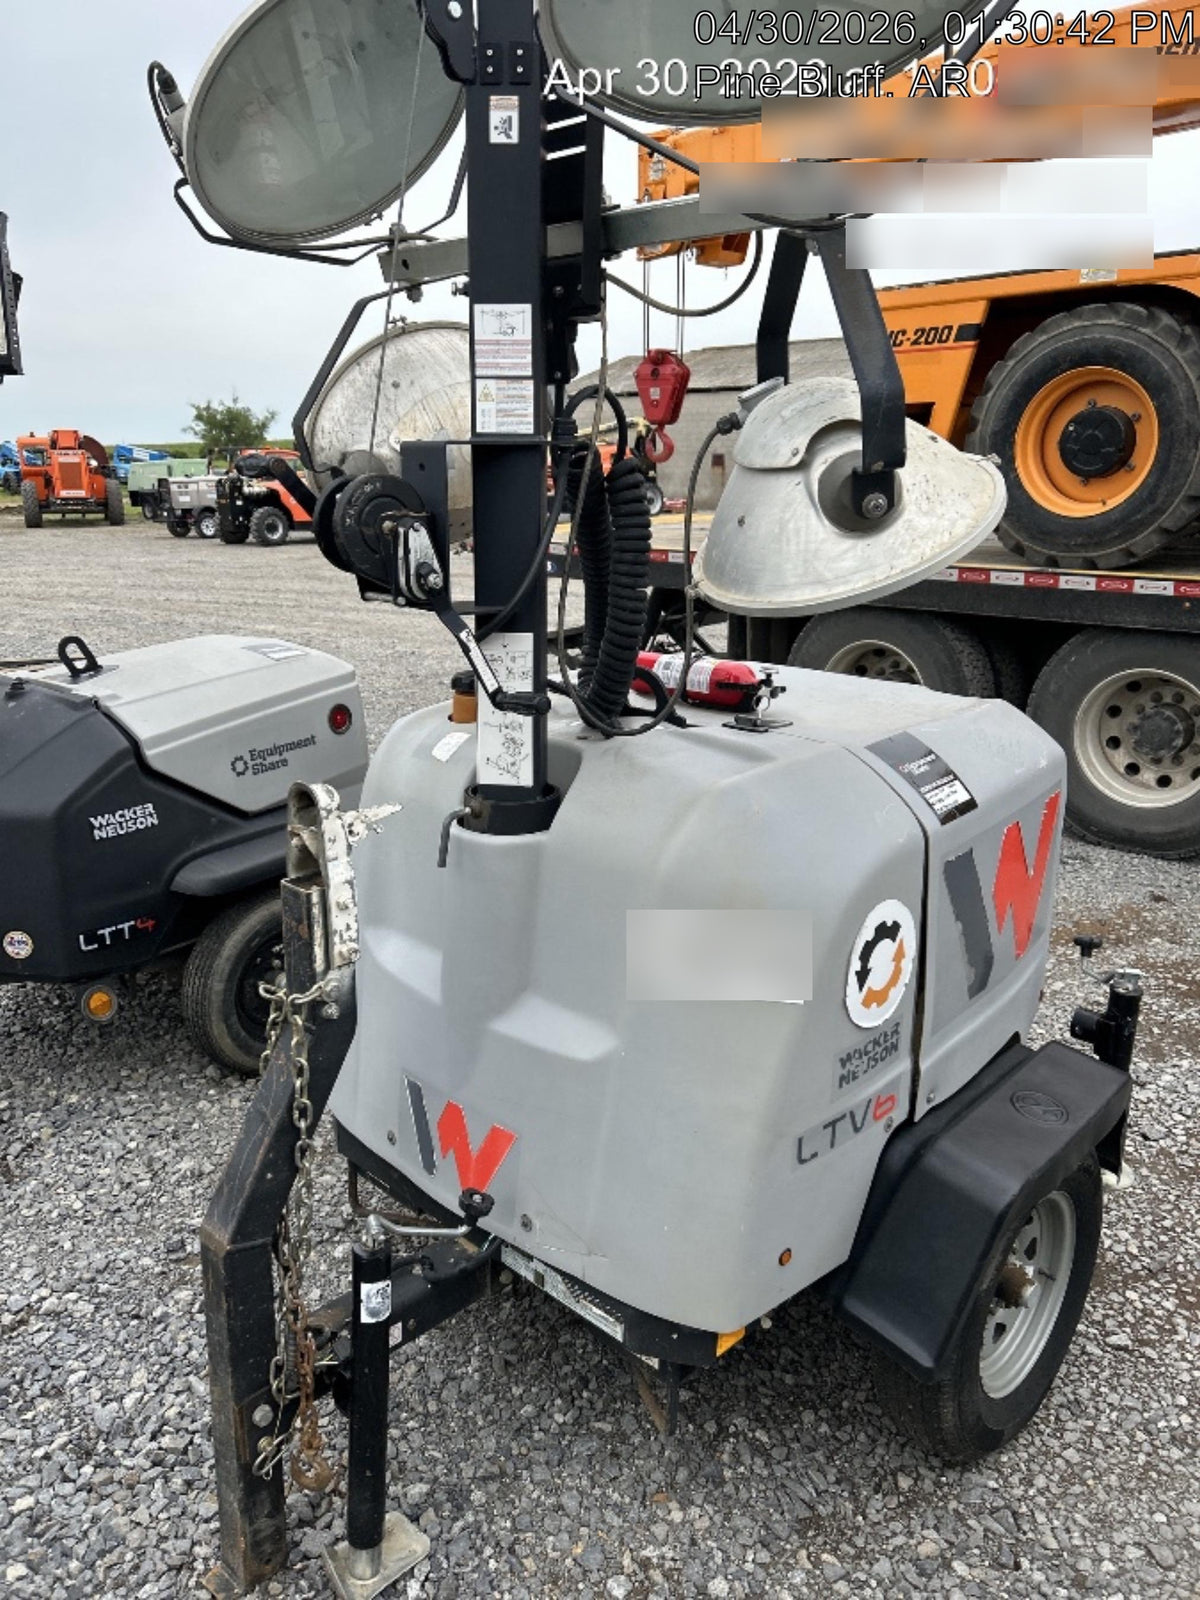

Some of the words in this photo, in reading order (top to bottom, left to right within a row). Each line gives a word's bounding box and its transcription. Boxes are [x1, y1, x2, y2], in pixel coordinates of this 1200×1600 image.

[248, 734, 317, 762] Equipment
[251, 758, 289, 776] Share
[88, 803, 156, 828] WACKER
[93, 813, 159, 841] NEUSON
[79, 918, 156, 951] LTT4
[797, 1093, 898, 1165] LTV6
